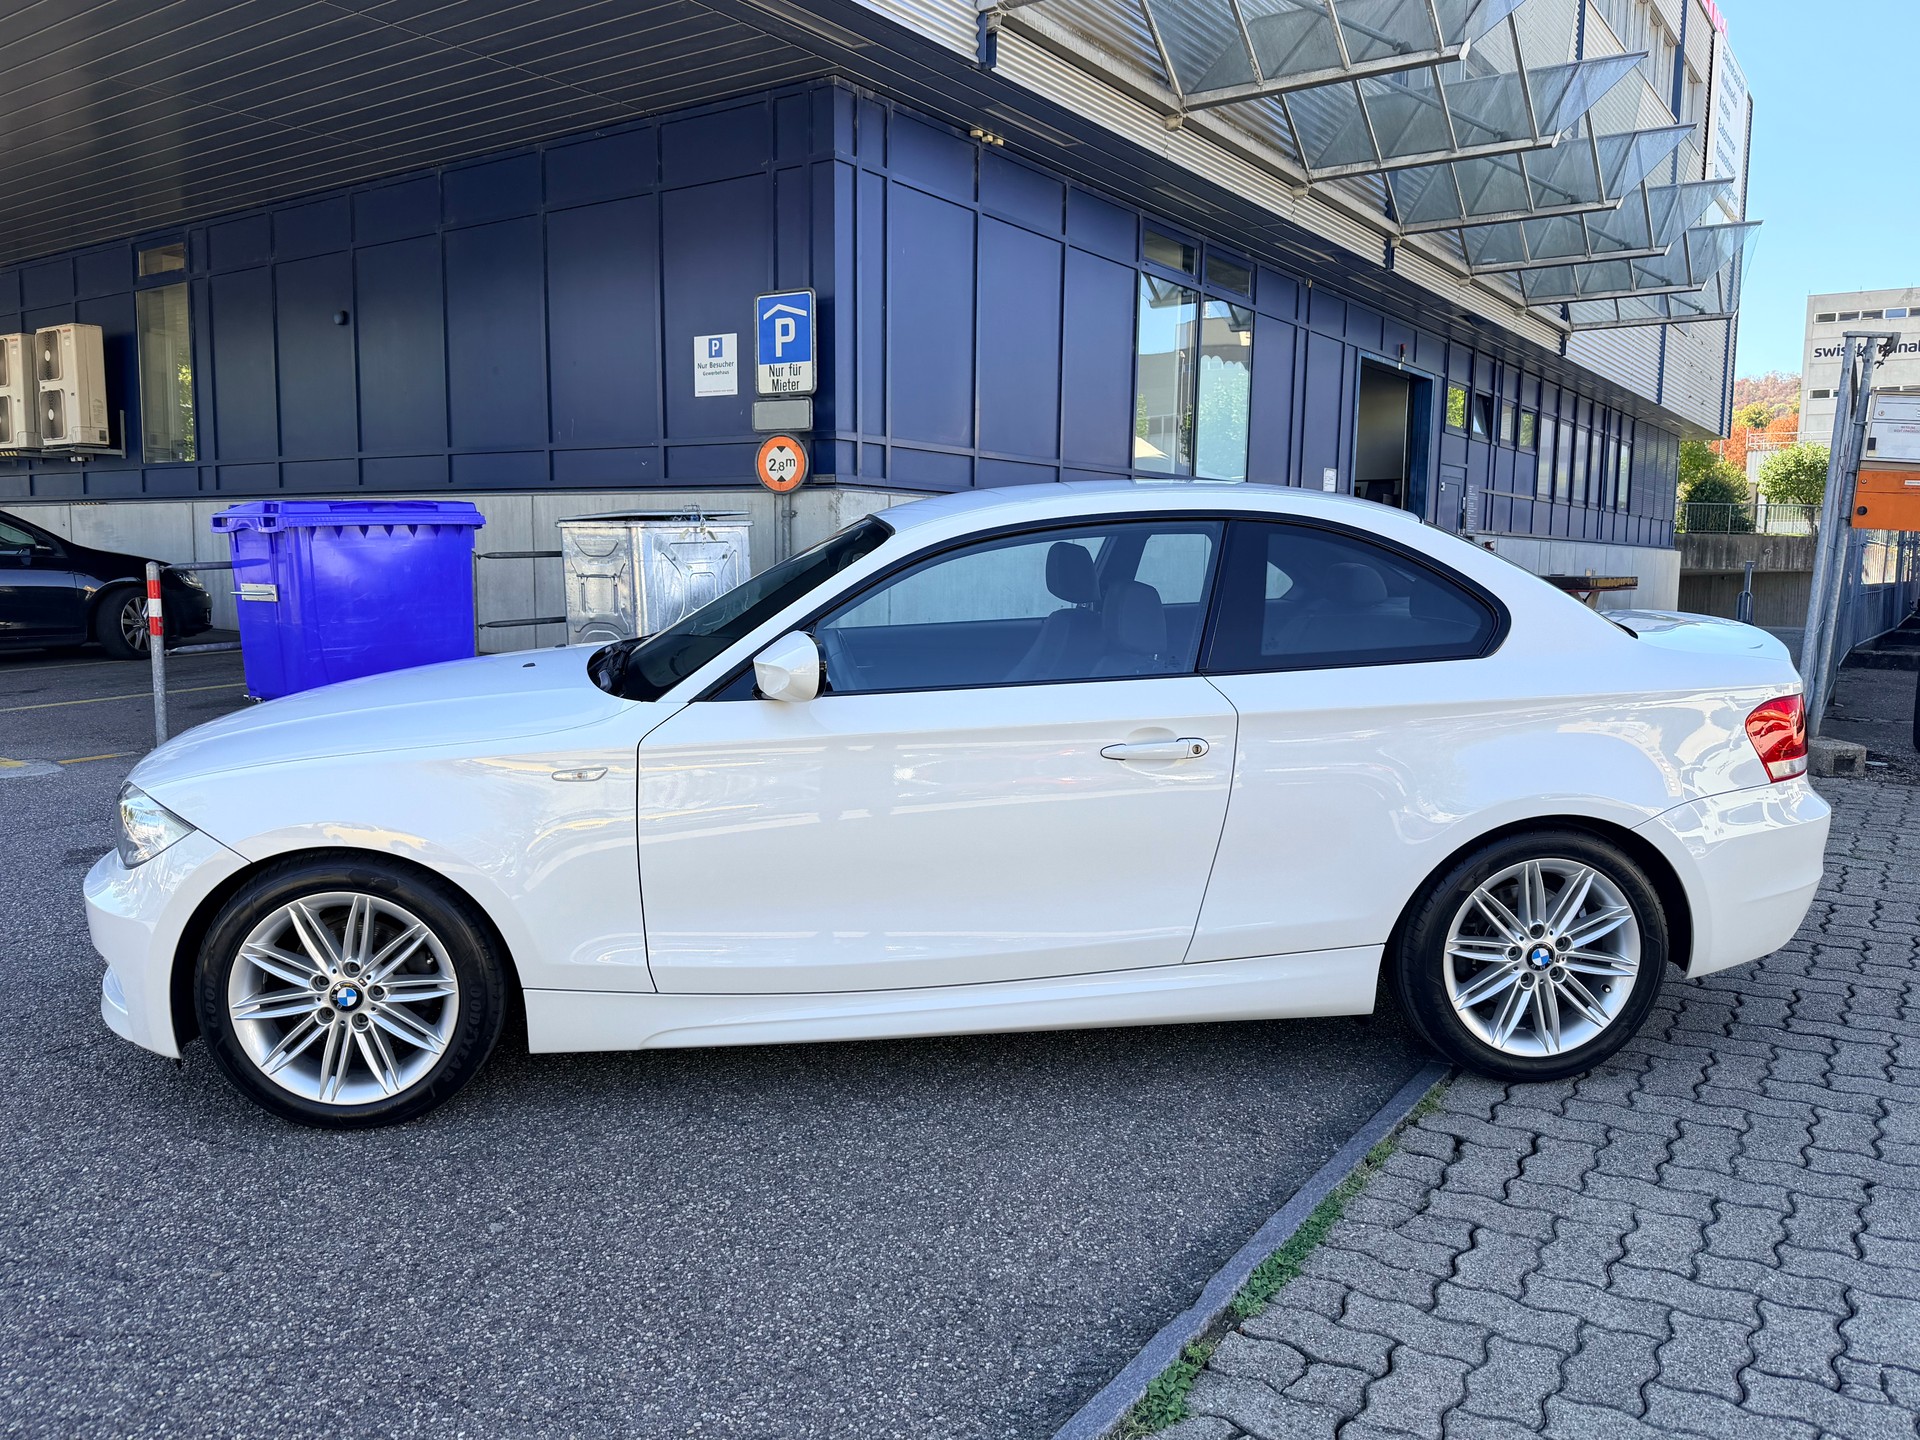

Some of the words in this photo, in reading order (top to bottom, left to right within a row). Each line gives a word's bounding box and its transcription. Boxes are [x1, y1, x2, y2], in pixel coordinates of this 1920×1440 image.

[774, 317, 796, 358] P
[711, 340, 720, 356] P
[709, 361, 734, 369] Besucher
[768, 365, 783, 378] Nur
[788, 363, 802, 376] für
[772, 378, 800, 392] Mieter
